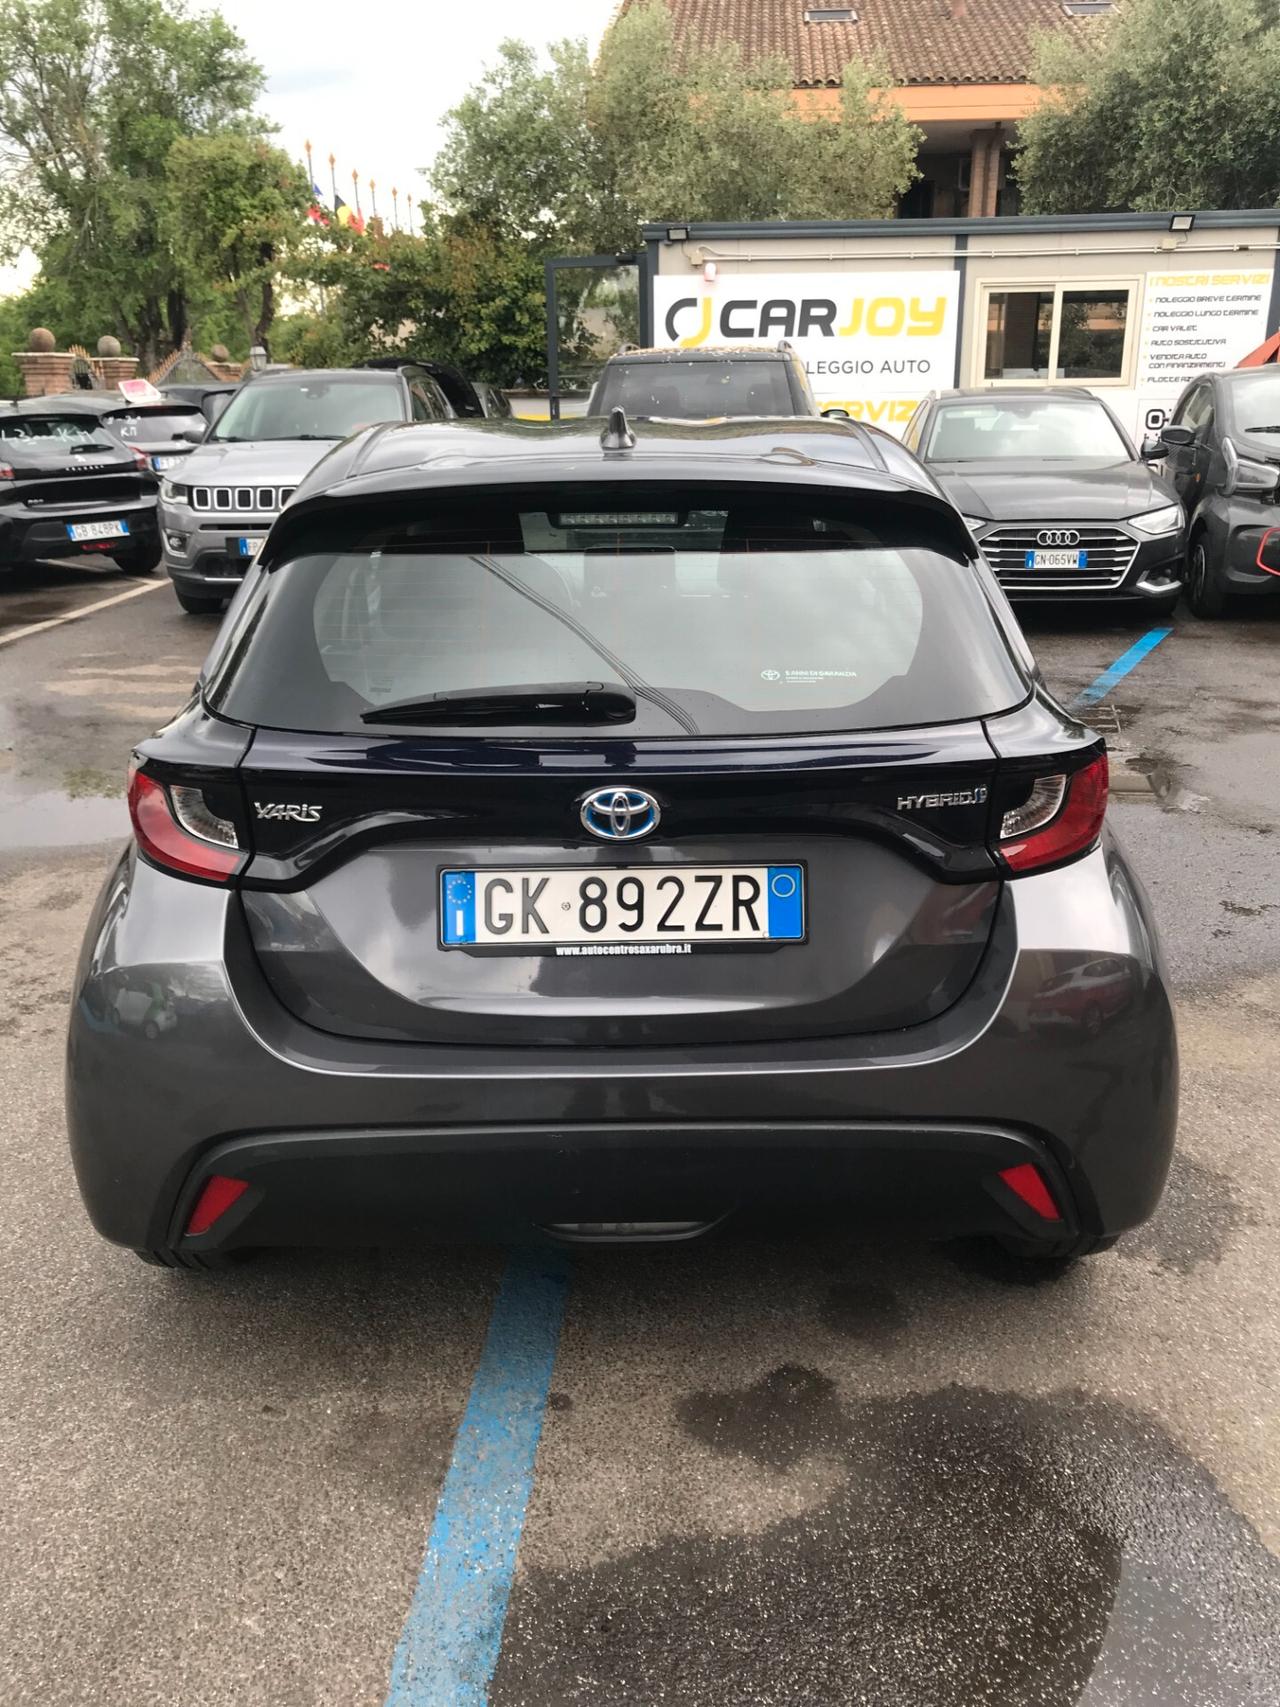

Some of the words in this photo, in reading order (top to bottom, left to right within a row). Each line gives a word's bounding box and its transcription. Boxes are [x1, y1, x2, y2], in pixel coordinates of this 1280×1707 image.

[1156, 275, 1209, 287] NOSTRI
[1211, 273, 1270, 286] SERVIZI
[1226, 294, 1262, 302] TERMINE
[1153, 310, 1194, 318] NOLEGGIO
[1170, 324, 1197, 332] VALET
[806, 360, 874, 374] LEGGIO
[880, 360, 931, 374] AUTO
[897, 792, 972, 810] HYBRID
[484, 877, 550, 936] GK
[578, 874, 761, 933] 892ZR
[555, 943, 692, 956] www.autocentrosaxarubra.it
